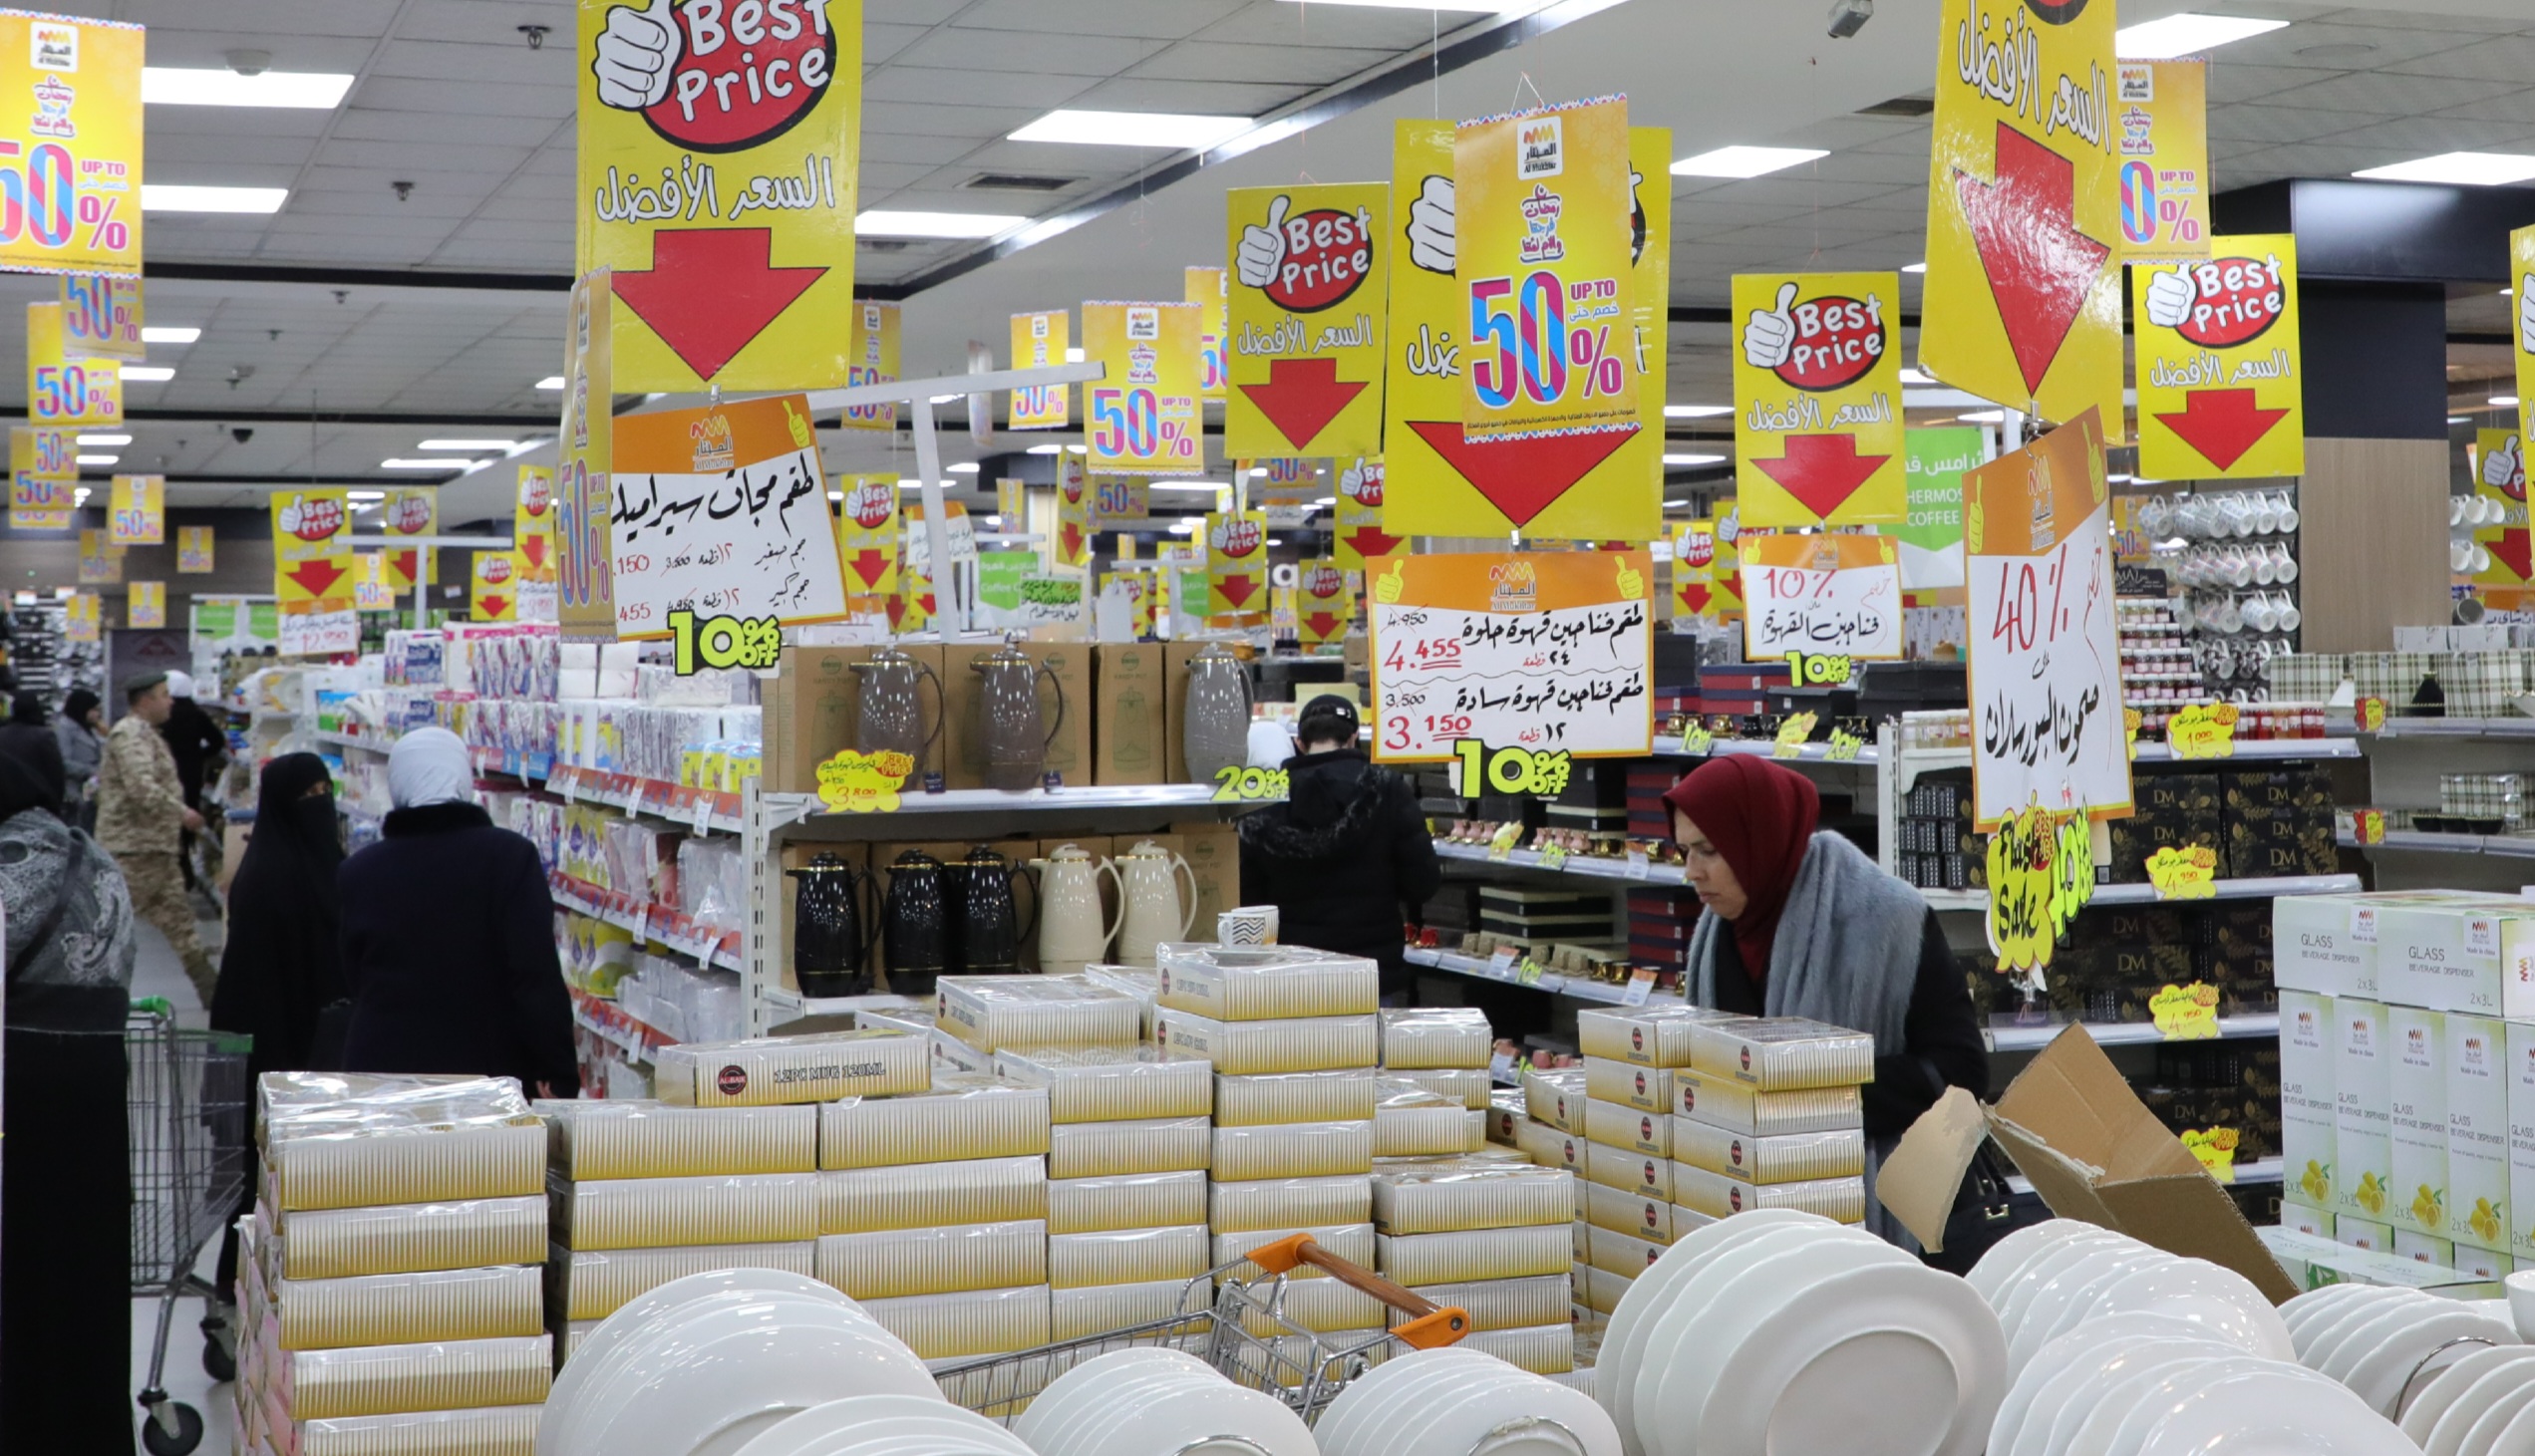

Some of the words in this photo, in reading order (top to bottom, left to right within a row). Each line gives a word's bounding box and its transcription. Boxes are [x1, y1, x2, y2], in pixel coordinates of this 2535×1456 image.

[683, 0, 831, 59] Best
[1959, 2, 2041, 123] الأفضل
[674, 46, 831, 123] Price
[2047, 60, 2111, 154] السعر
[82, 160, 103, 173] UP
[106, 162, 125, 175] TO
[2160, 171, 2177, 181] UP
[2178, 170, 2195, 181] TO
[595, 154, 719, 223] الأفضل
[729, 152, 836, 220] السعر
[2120, 161, 2199, 243] 0%
[1286, 205, 1372, 255] Best
[1282, 247, 1371, 295] Price
[2198, 253, 2282, 297] Best
[1570, 282, 1592, 301] UP
[1594, 279, 1615, 298] TO
[1570, 305, 1590, 322] حتى
[1592, 302, 1620, 320] خصم
[1794, 293, 1883, 340] Best
[2194, 290, 2283, 334] Price
[1237, 314, 1307, 358] الأفضل
[1313, 313, 1375, 354] السعر
[1470, 270, 1624, 409] 50%
[1792, 329, 1882, 376] Price
[2150, 349, 2224, 388] الأفضل
[2230, 348, 2292, 386] السعر
[36, 365, 115, 418] 50%
[1015, 385, 1064, 418] 50%
[1094, 388, 1194, 458] 50%
[1746, 397, 1822, 433] الأفضل
[1829, 393, 1893, 431] السعر
[36, 432, 77, 473] 50%
[1270, 457, 1314, 482] 50%
[1363, 465, 1384, 482] Be
[780, 451, 814, 537] طقم
[863, 484, 894, 504] Best
[1099, 483, 1145, 513] 50%
[1906, 488, 1963, 504] HERMOS
[303, 498, 344, 518] Best
[861, 500, 893, 522] Price
[1907, 510, 1960, 527] COFFEE
[116, 509, 159, 538] 50%
[301, 512, 344, 536] Price
[560, 458, 610, 607] 50%
[1228, 520, 1261, 536] Best
[1227, 533, 1261, 552] Price
[2115, 529, 2147, 557] 50%
[613, 554, 651, 576] .150
[769, 572, 799, 608] كبير
[1316, 579, 1342, 593] Price
[1762, 568, 1837, 600] 10%
[1491, 601, 1502, 611] Al
[1503, 601, 1536, 611] Mukhtar
[1994, 543, 2068, 654] 40%
[616, 602, 651, 622] .455
[1387, 611, 1428, 628] 4.950
[1462, 616, 1504, 649] حلوة
[1506, 610, 1550, 646] قهوة
[1551, 611, 1613, 648] فناجين
[1610, 603, 1644, 659] طقم
[1762, 609, 1810, 644] القهوة
[1811, 611, 1880, 646] فناجين
[667, 609, 783, 677] 10%
[1384, 638, 1462, 672] 4.455
[738, 645, 781, 668] OFF
[1522, 653, 1545, 667] قطعة
[1784, 651, 1850, 688] 10%
[1385, 694, 1426, 708] 3.500
[1454, 687, 1511, 713] سادة
[1512, 679, 1555, 713] قهوة
[1557, 680, 1613, 713] فناجين
[1609, 672, 1644, 716] طقم
[1385, 715, 1472, 750] 3.150
[1518, 727, 1540, 741] قطعة
[1681, 724, 1712, 752] 10%
[1823, 727, 1862, 759] 20%
[882, 763, 913, 775] Price
[887, 753, 915, 765] Best
[1454, 738, 1571, 798] 10%
[832, 785, 877, 806] 3.800
[1209, 764, 1291, 804] 20%
[1531, 774, 1569, 794] OFF
[2268, 787, 2289, 800] DM
[2154, 789, 2175, 804] DM
[2035, 809, 2055, 835] Best
[2154, 826, 2175, 840] DM
[2273, 821, 2294, 835] DM
[2270, 848, 2297, 867] DM
[1999, 876, 2040, 942] Sale
[2113, 917, 2139, 935] DM
[2301, 933, 2333, 948] GLASS
[2118, 954, 2146, 972] DM
[2301, 950, 2330, 961] BEVERAGE
[2332, 953, 2361, 964] DISPENSER
[2408, 946, 2445, 961] GLASS
[1515, 956, 1543, 984] 10%
[2409, 963, 2440, 974] BEVERAGE
[2444, 967, 2474, 978] DISPENSER
[2358, 979, 2377, 991] 2x3L
[2470, 994, 2493, 1007] 2x3L
[775, 1069, 807, 1083] 12PC
[808, 1066, 839, 1080] MUG
[842, 1062, 885, 1077] 120ML
[2283, 1082, 2303, 1094] GLASS
[2338, 1092, 2359, 1104] GLASS
[2175, 1105, 2196, 1119] DM
[2283, 1095, 2307, 1107] BEVERAGE
[2308, 1099, 2333, 1110] DISPENSER
[2338, 1105, 2363, 1117] BEVERAGE
[2364, 1108, 2389, 1121] DISPENSER
[2392, 1103, 2413, 1115] GLASS
[2392, 1116, 2417, 1128] BEVERAGE
[2419, 1120, 2445, 1133] DISPENSER
[2450, 1113, 2471, 1126] GLASS
[2512, 1124, 2534, 1138] GLASS
[2450, 1127, 2475, 1140] BEVERAGE
[2476, 1132, 2504, 1145] DISPENSER
[2285, 1179, 2305, 1195] 2x3L
[2340, 1191, 2360, 1208] 2x3L
[2394, 1205, 2415, 1221] 2x3L
[2451, 1217, 2473, 1236] 2x3L
